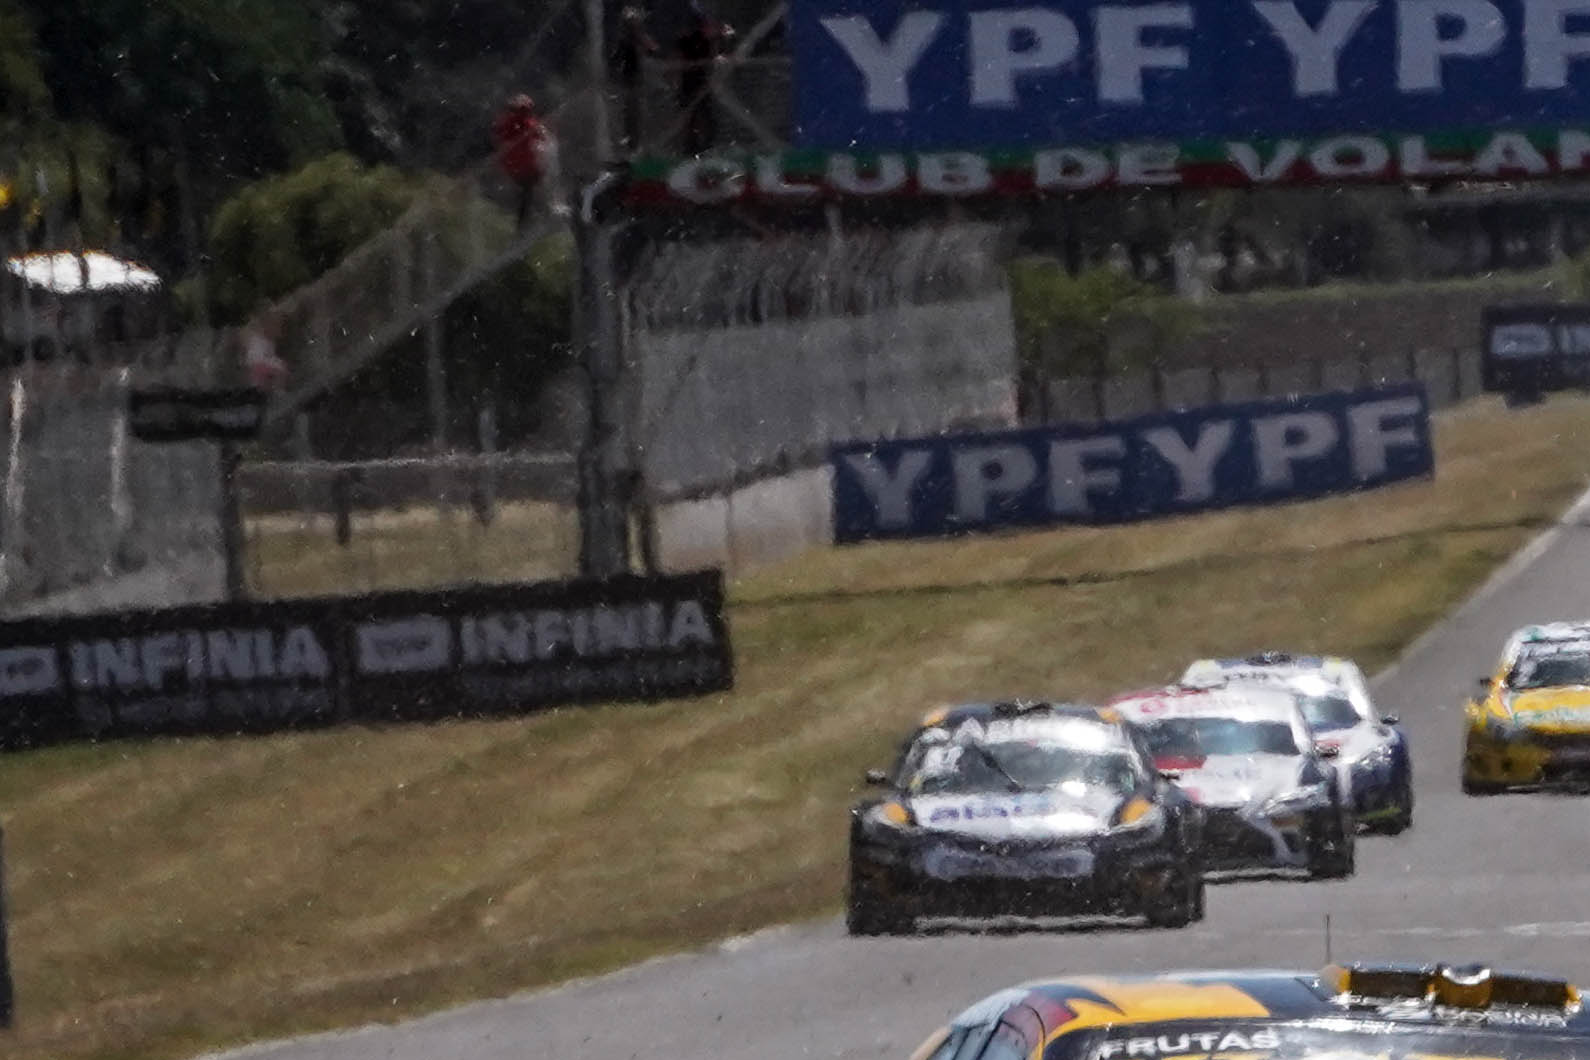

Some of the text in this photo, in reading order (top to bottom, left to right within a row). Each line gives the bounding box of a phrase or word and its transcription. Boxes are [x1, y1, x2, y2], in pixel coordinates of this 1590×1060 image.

[820, 5, 1195, 113] YPF
[667, 148, 994, 200] CLUB
[1033, 145, 1184, 190] DE
[71, 625, 330, 689] INFINIA
[460, 600, 714, 663] INFINIA
[1102, 1029, 1280, 1059] FRUTAS
